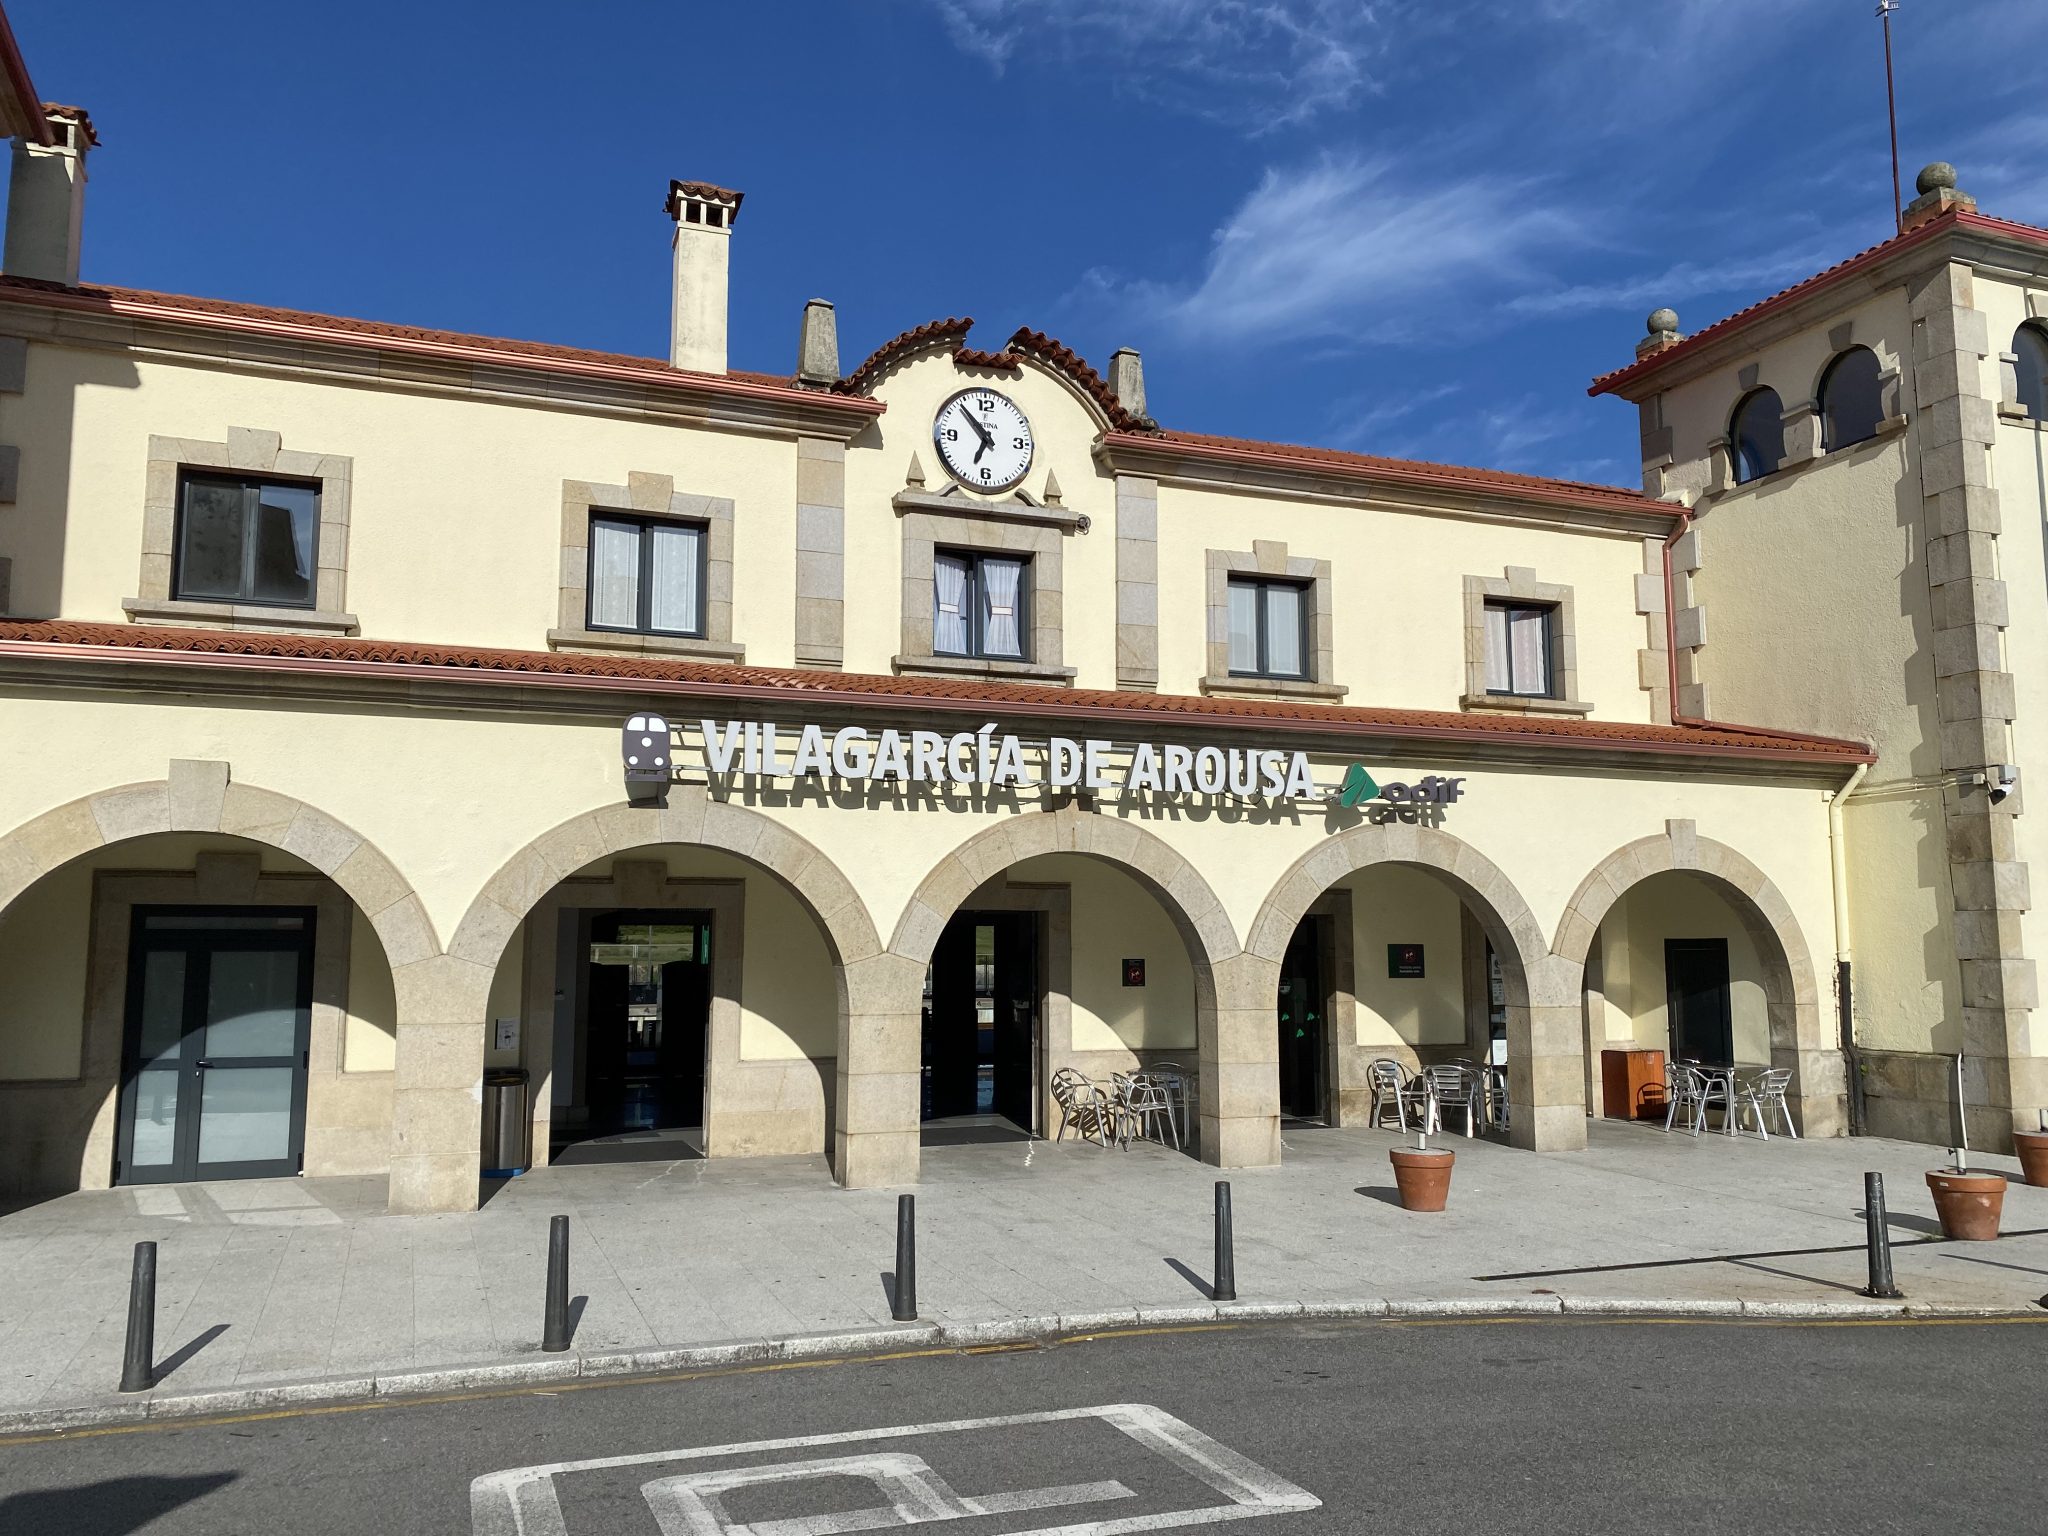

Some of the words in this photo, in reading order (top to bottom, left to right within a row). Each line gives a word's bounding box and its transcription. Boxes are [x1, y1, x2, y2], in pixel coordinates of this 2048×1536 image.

[976, 399, 995, 412] 12
[947, 429, 958, 441] 9
[1013, 438, 1024, 449] 3
[980, 467, 991, 480] 6
[701, 720, 1030, 784] VILAGARCÍA
[1050, 737, 1112, 788] DE
[1128, 743, 1317, 799] AROUSA
[1381, 776, 1466, 803] adif
